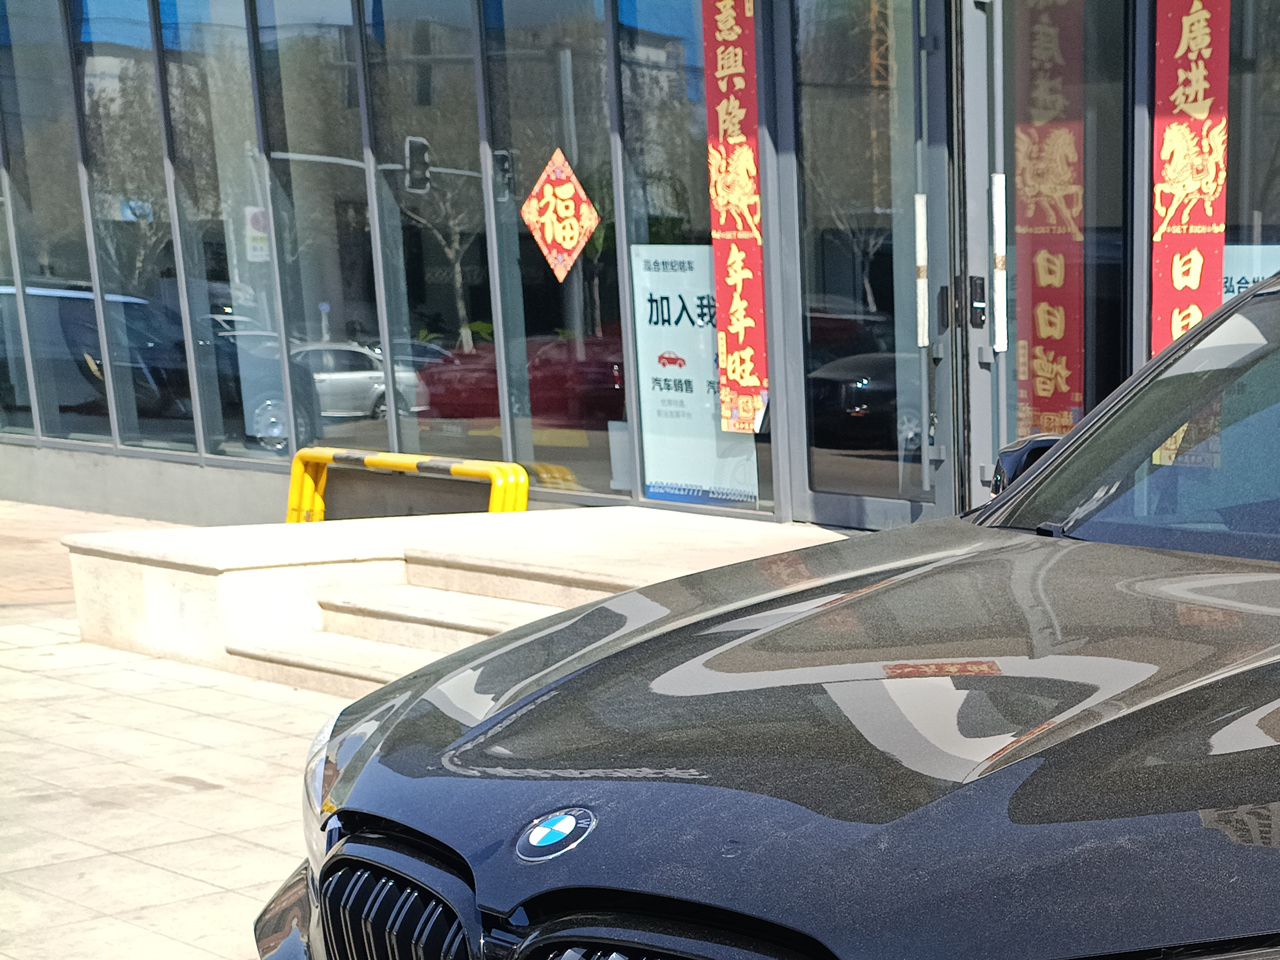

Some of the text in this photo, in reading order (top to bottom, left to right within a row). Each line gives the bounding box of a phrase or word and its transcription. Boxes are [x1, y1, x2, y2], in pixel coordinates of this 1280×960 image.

[539, 183, 580, 250] 福
[647, 292, 717, 328] 加入我
[652, 377, 694, 393] 汽车销售
